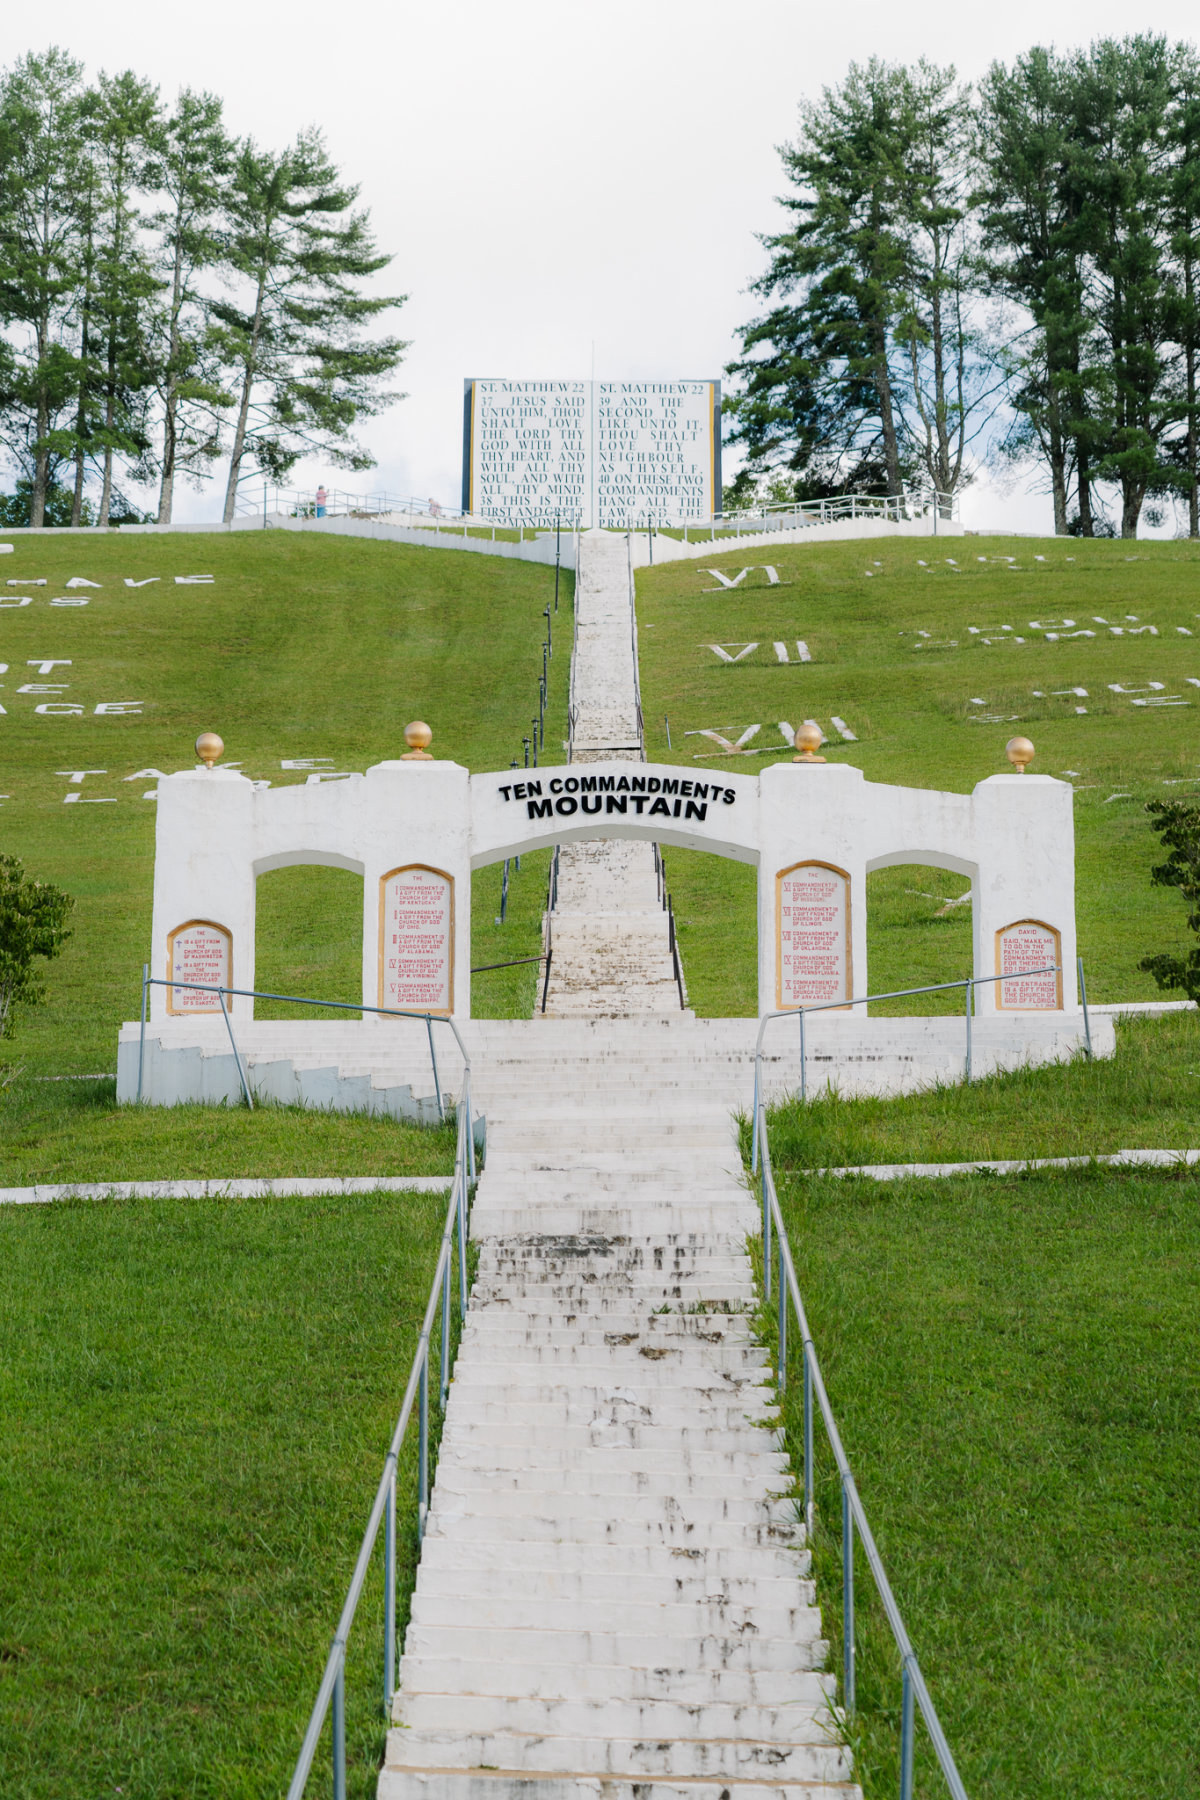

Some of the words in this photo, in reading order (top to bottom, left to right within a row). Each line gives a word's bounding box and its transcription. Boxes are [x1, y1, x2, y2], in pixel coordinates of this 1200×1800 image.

[481, 383, 498, 392] ST.
[502, 383, 570, 392] MATTHEW
[572, 383, 584, 392] 22
[600, 384, 617, 393] ST.
[621, 384, 688, 393] MATTHEW
[692, 385, 704, 394] 22
[481, 396, 493, 406] 37
[510, 396, 546, 406] JESUS
[555, 396, 585, 406] SAID
[600, 397, 610, 407] 39
[621, 397, 647, 407] AND
[660, 397, 684, 407] THE
[481, 408, 515, 417] UNTO
[520, 408, 547, 419] HIM,
[551, 408, 584, 417] THOU
[599, 408, 653, 418] SECOND
[664, 408, 677, 418] IS
[481, 418, 526, 428] SHALT
[549, 418, 581, 428] LOVE
[599, 419, 630, 429] LIKE
[640, 419, 677, 429] UNTO
[687, 420, 703, 432] IT,
[481, 429, 505, 439] THE
[515, 429, 550, 439] LORD
[559, 429, 584, 439] THY
[599, 430, 638, 440] THOU
[650, 430, 697, 440] SHALT
[481, 440, 509, 450] GOD
[519, 440, 552, 450] WITH
[561, 440, 584, 450] ALL
[599, 441, 636, 451] LOVE
[655, 441, 684, 451] THY
[481, 451, 504, 461] THY
[512, 451, 554, 462] HEART,
[558, 451, 585, 461] AND
[599, 452, 684, 462] NEIGHBOUR
[481, 462, 515, 472] WITH
[525, 462, 549, 472] ALL
[559, 462, 584, 472] THY
[599, 464, 615, 474] AS
[628, 464, 703, 474] THYSELF.
[480, 473, 515, 484] SOUL,
[521, 473, 548, 484] AND
[553, 473, 584, 484] WITH
[599, 474, 610, 484] 40
[615, 474, 632, 484] ON
[637, 474, 672, 484] THESE
[677, 474, 703, 484] TWO
[481, 484, 504, 494] ALL
[515, 484, 538, 494] THY
[548, 484, 584, 494] MIND.
[598, 485, 704, 496] COMMANDMENTS
[481, 496, 492, 506] 38
[502, 496, 530, 506] THIS
[540, 496, 551, 506] IS
[558, 496, 581, 506] THE
[599, 496, 635, 507] HANG
[646, 496, 669, 507] ALL
[679, 496, 703, 507] THE
[481, 507, 513, 517] FIRST
[518, 507, 542, 517] AND
[599, 508, 627, 518] LAW
[638, 508, 667, 518] AND
[677, 508, 703, 518] THE
[6, 574, 214, 589] HAVE
[697, 641, 812, 664] VII
[498, 780, 543, 801] TEN
[550, 776, 736, 805] COMMANDMENTS
[528, 795, 708, 820] MOUNTAIN
